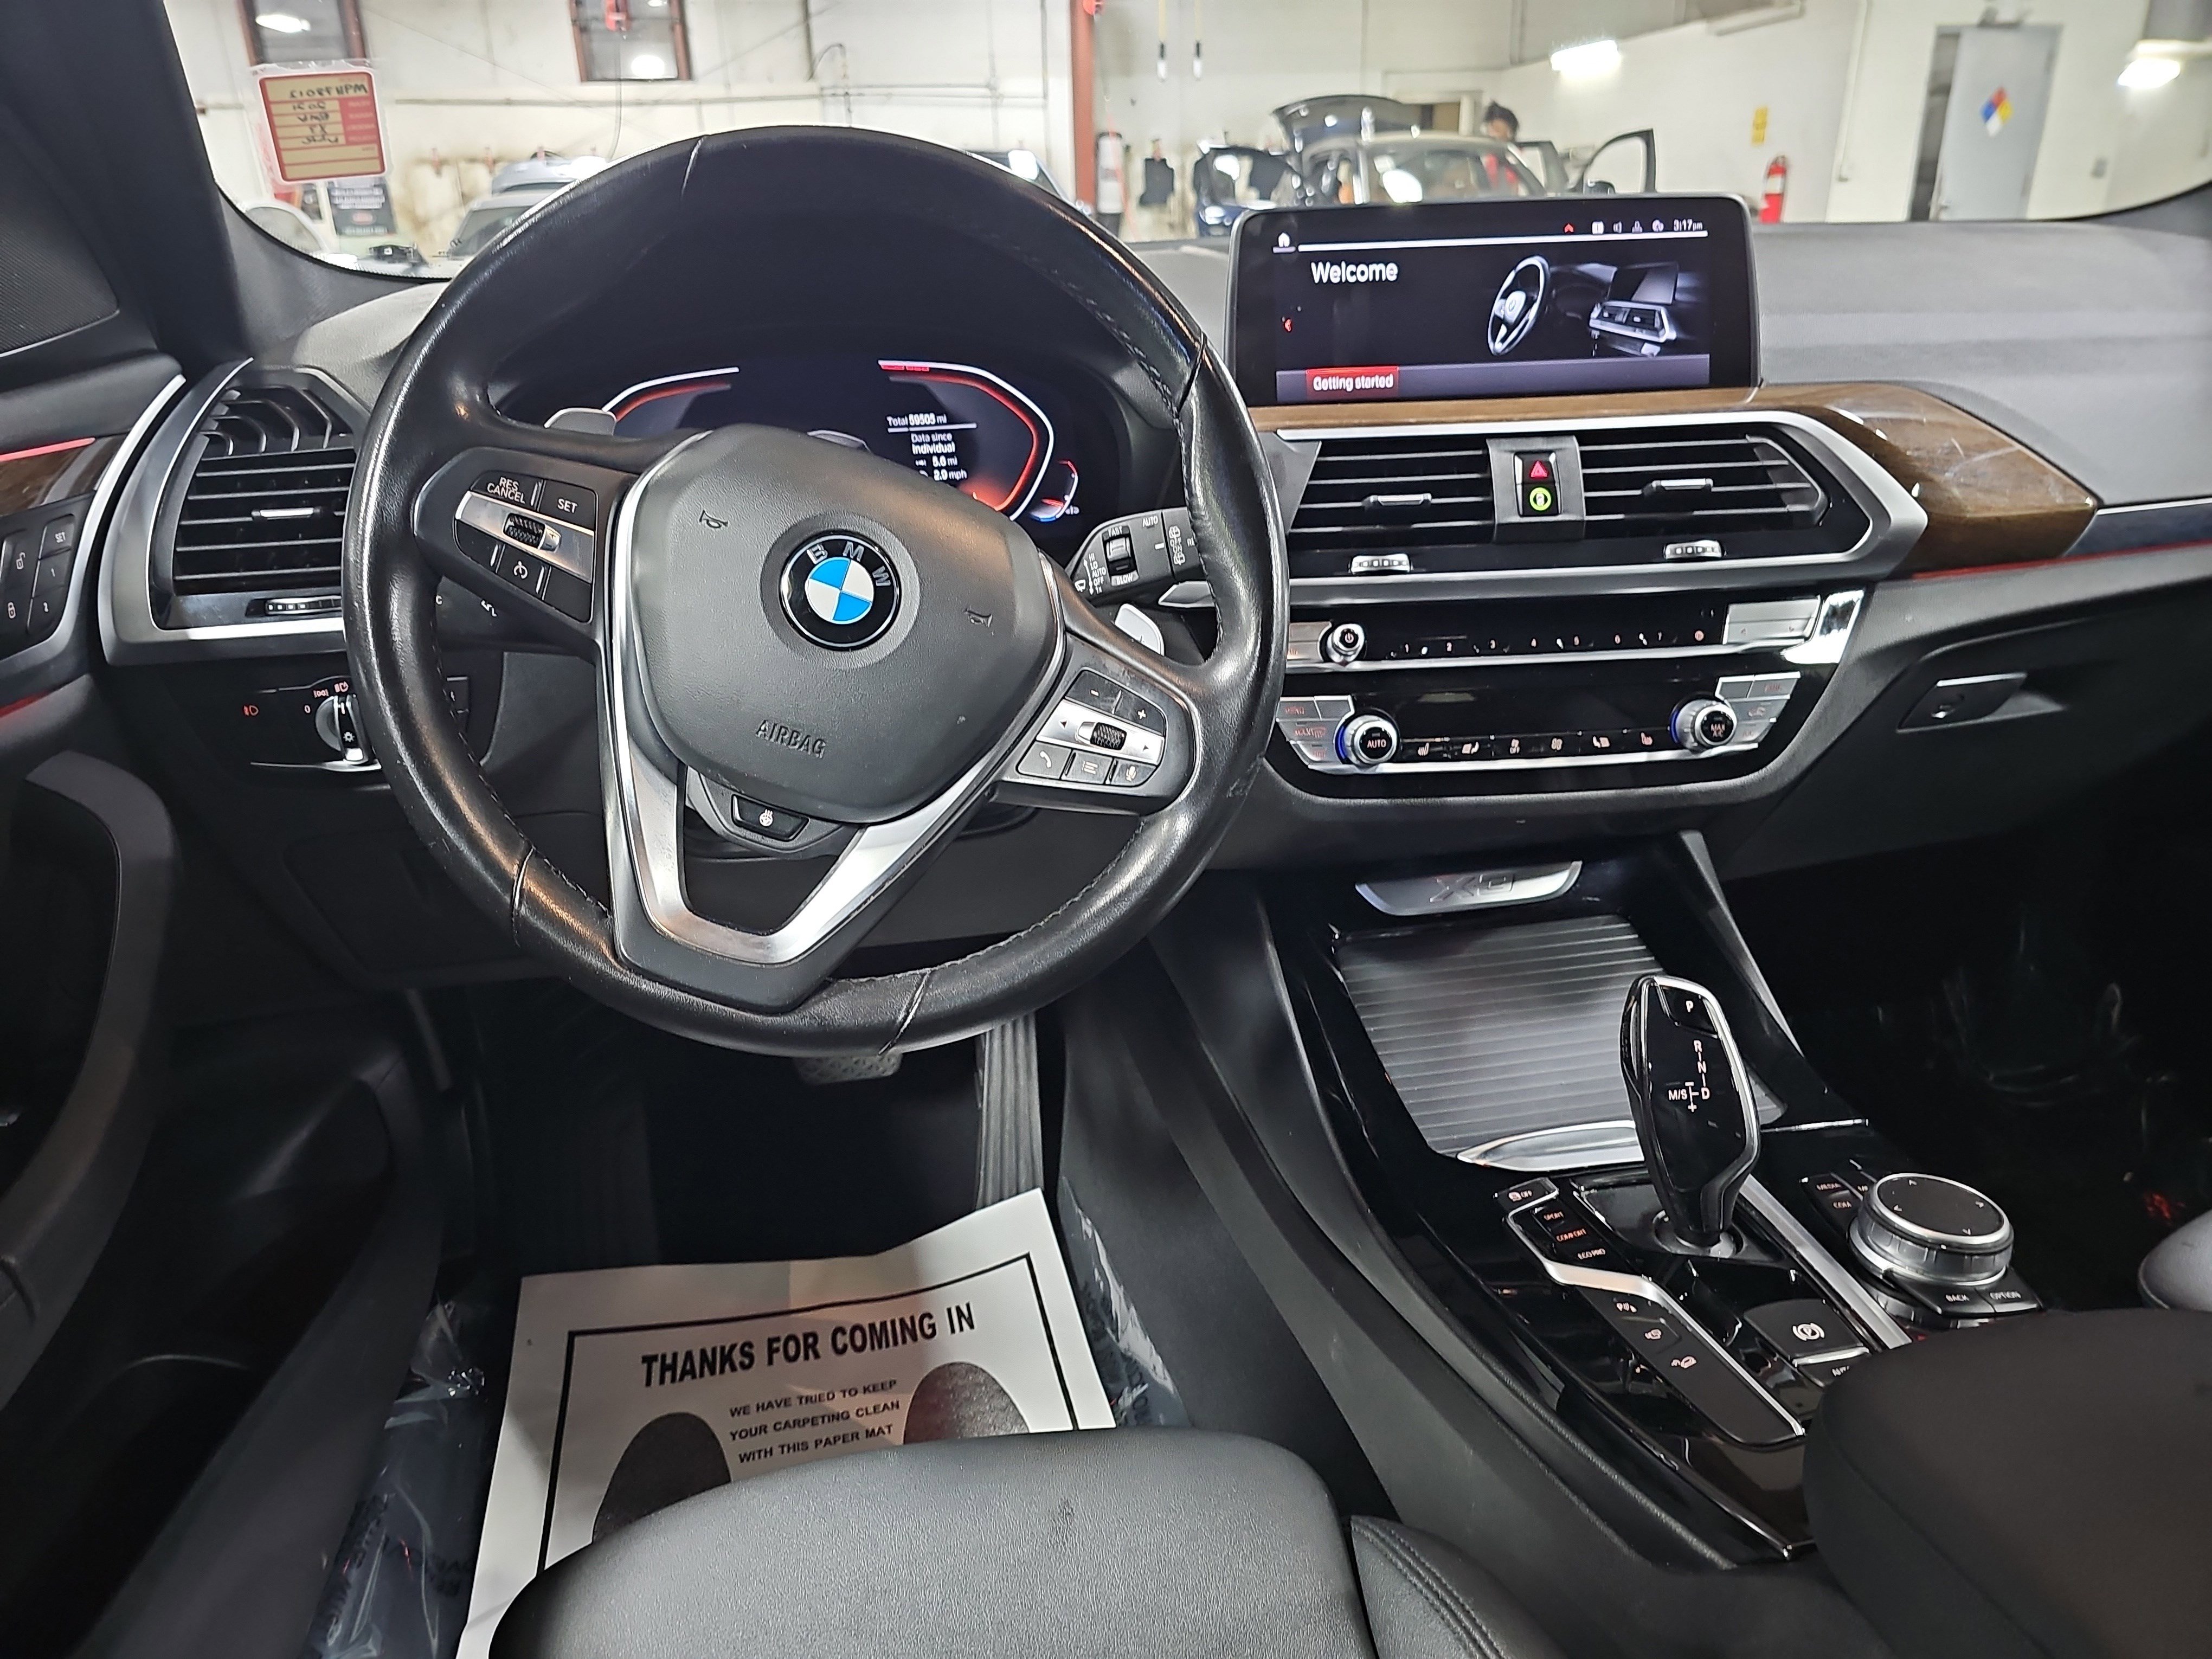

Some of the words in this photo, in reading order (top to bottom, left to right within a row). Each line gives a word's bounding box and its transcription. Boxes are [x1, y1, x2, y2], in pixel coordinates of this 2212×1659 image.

[1310, 260, 1399, 284] Welcome
[1313, 375, 1354, 392] Getting
[1355, 373, 1394, 389] started
[886, 416, 908, 427] Total
[911, 433, 930, 443] Data
[931, 432, 953, 442] since
[912, 441, 956, 455] Individual
[949, 468, 967, 481] mph
[499, 477, 519, 491] RES
[487, 483, 526, 504] CANCEL
[557, 498, 578, 513] SET
[1142, 516, 1159, 528] AUTO
[55, 531, 66, 543] SET
[806, 541, 892, 587] BMW
[1090, 561, 1098, 570] LO
[1092, 567, 1107, 578] AUTO
[1093, 576, 1104, 587] OFF
[755, 718, 827, 760] AIRBAG
[1367, 739, 1386, 748] AUTO
[1429, 872, 1514, 903] X3
[1686, 1000, 1694, 1013] P
[1693, 1040, 1703, 1052] R
[1697, 1060, 1707, 1073] N
[1668, 1088, 1687, 1100] M/S
[1701, 1088, 1710, 1100] D
[640, 1340, 756, 1388] THANKS
[766, 1331, 821, 1367] FOR
[830, 1311, 938, 1356] COMING
[946, 1301, 976, 1335] IN
[729, 1405, 751, 1418] WE
[755, 1397, 793, 1413] HAVE
[796, 1391, 835, 1406] TRIED
[840, 1387, 858, 1399] TO
[862, 1379, 897, 1395] KEEP
[729, 1424, 768, 1441] YOUR
[773, 1410, 850, 1432] CARPETING
[854, 1399, 900, 1418] CLEAN
[738, 1446, 773, 1464] WITH
[778, 1441, 809, 1456] THIS
[814, 1431, 860, 1449] PAPER
[865, 1424, 894, 1438] MAT
